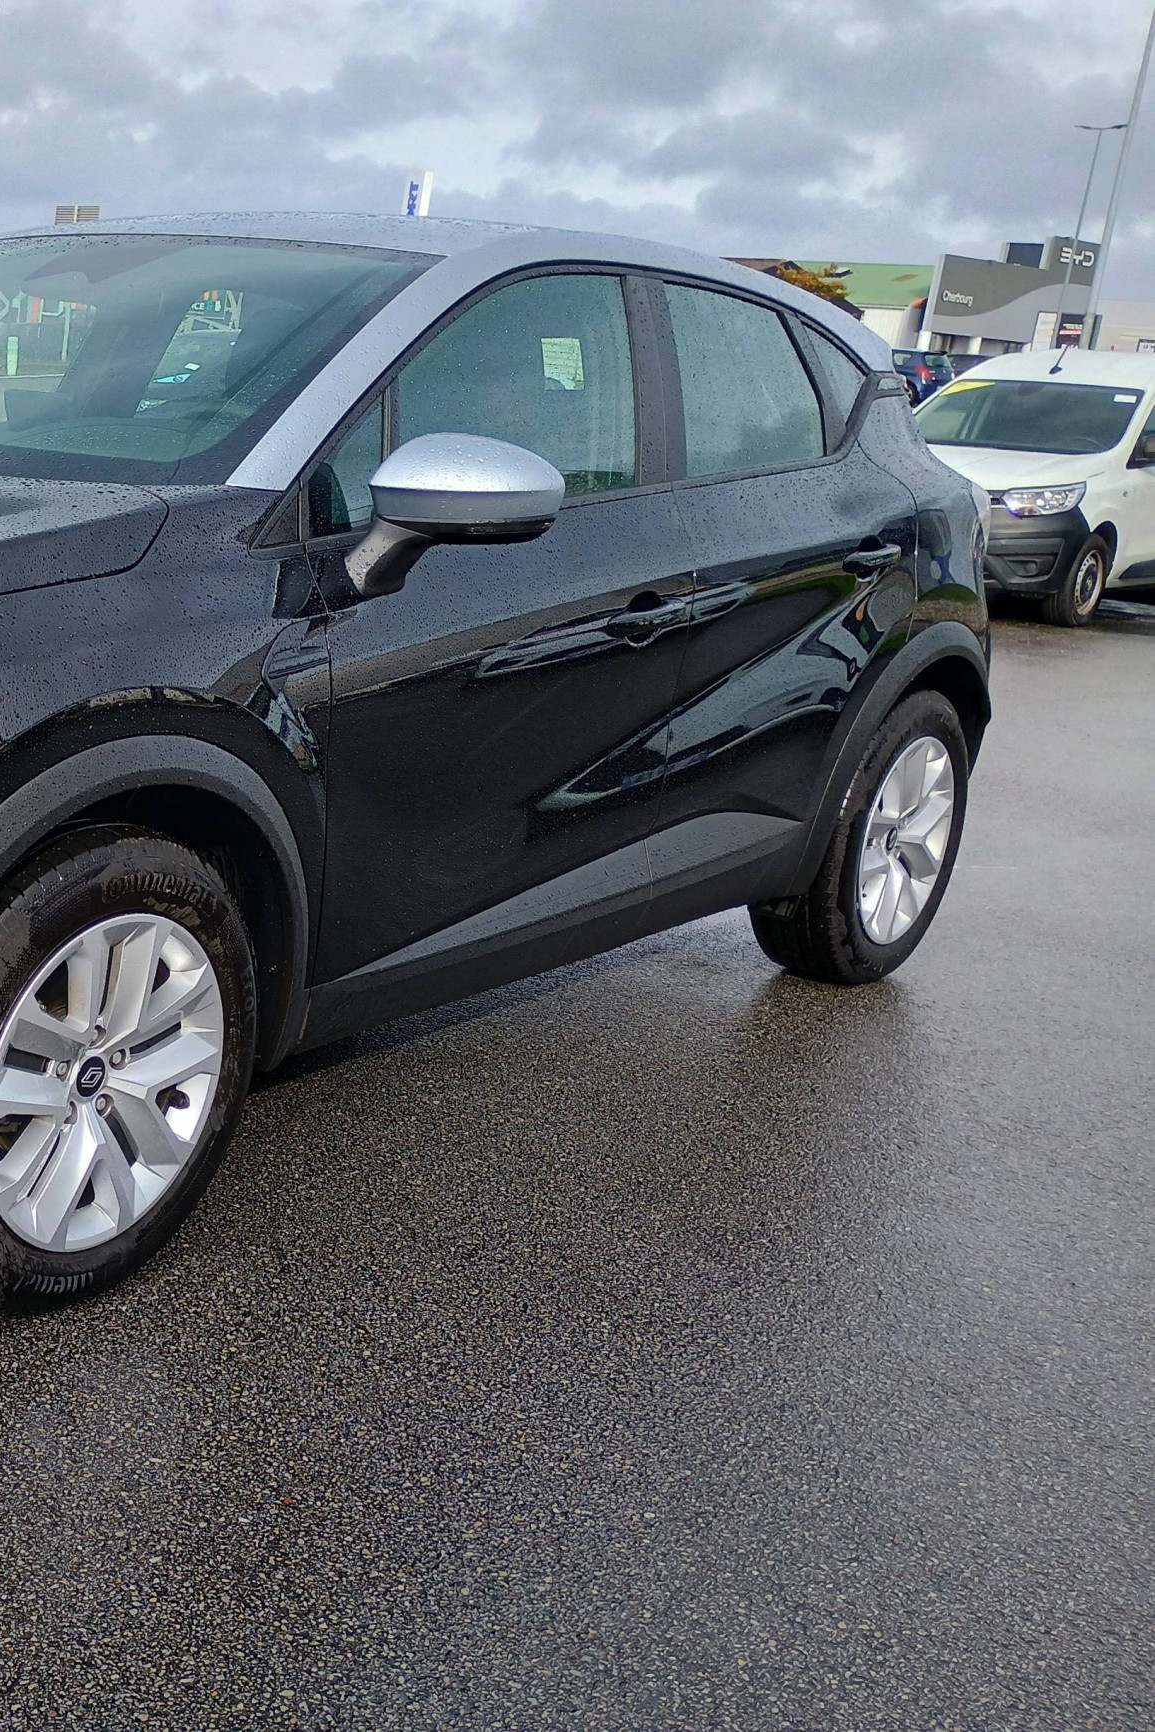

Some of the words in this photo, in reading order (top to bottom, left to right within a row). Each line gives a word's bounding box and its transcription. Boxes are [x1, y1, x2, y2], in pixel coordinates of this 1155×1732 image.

[1060, 247, 1095, 267] BYD
[943, 290, 974, 307] Cherbourg
[102, 870, 210, 904] Continental
